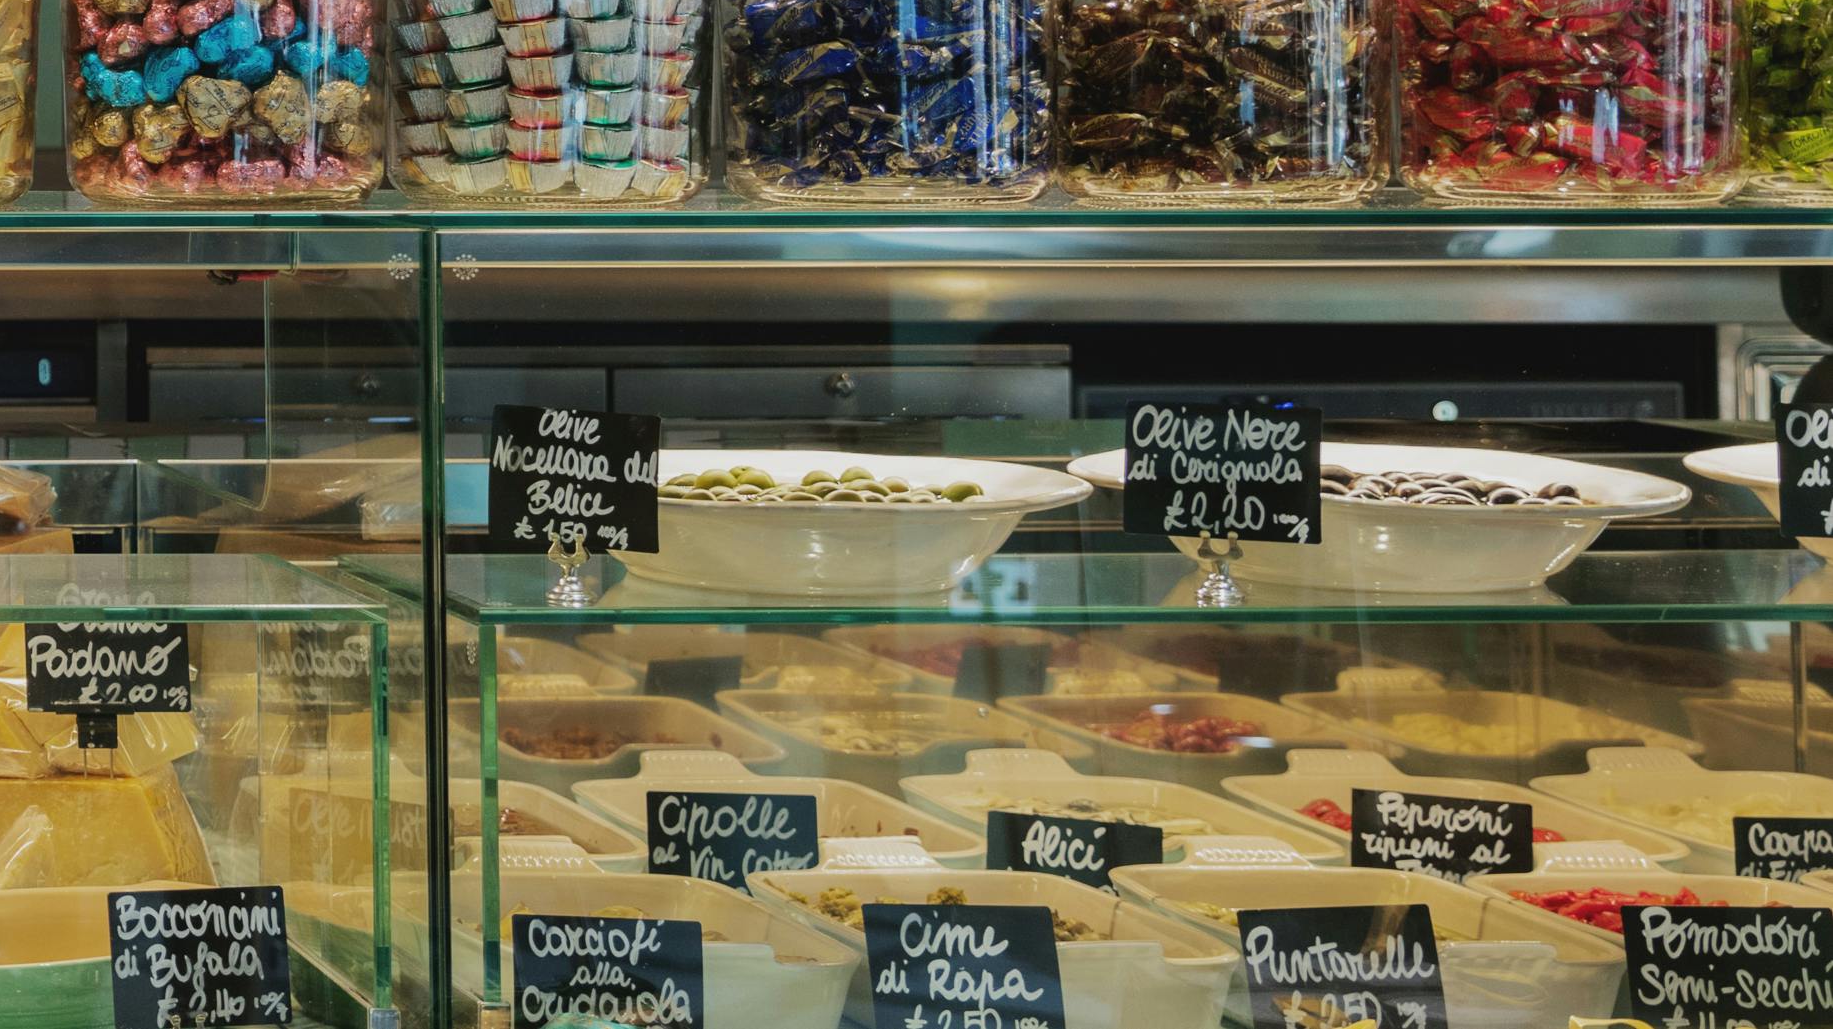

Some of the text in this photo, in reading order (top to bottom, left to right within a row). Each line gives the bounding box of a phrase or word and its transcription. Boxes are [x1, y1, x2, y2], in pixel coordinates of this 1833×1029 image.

[540, 410, 600, 443] Olive
[1134, 406, 1304, 452] Olive Nere
[494, 438, 659, 483] Nocellara del
[1130, 452, 1302, 486] di Cerignola
[1798, 455, 1831, 487] di
[527, 483, 614, 518] Belice
[29, 638, 180, 676] Padano
[658, 796, 796, 846] Cipolle
[1377, 792, 1512, 836] Peperoni
[654, 846, 680, 865] al
[690, 846, 734, 878] Vin
[1022, 822, 1106, 870] Alici
[1361, 833, 1511, 865] ripieni al
[117, 892, 281, 938] Bocconcini
[900, 912, 1009, 958] Cime
[1641, 907, 1822, 958] Pomodori
[528, 919, 664, 961] Carciofi
[1246, 926, 1435, 985] Puntarelle
[116, 949, 263, 987] di Bufala
[570, 963, 632, 988] alla
[876, 959, 1044, 1002] di Rapa
